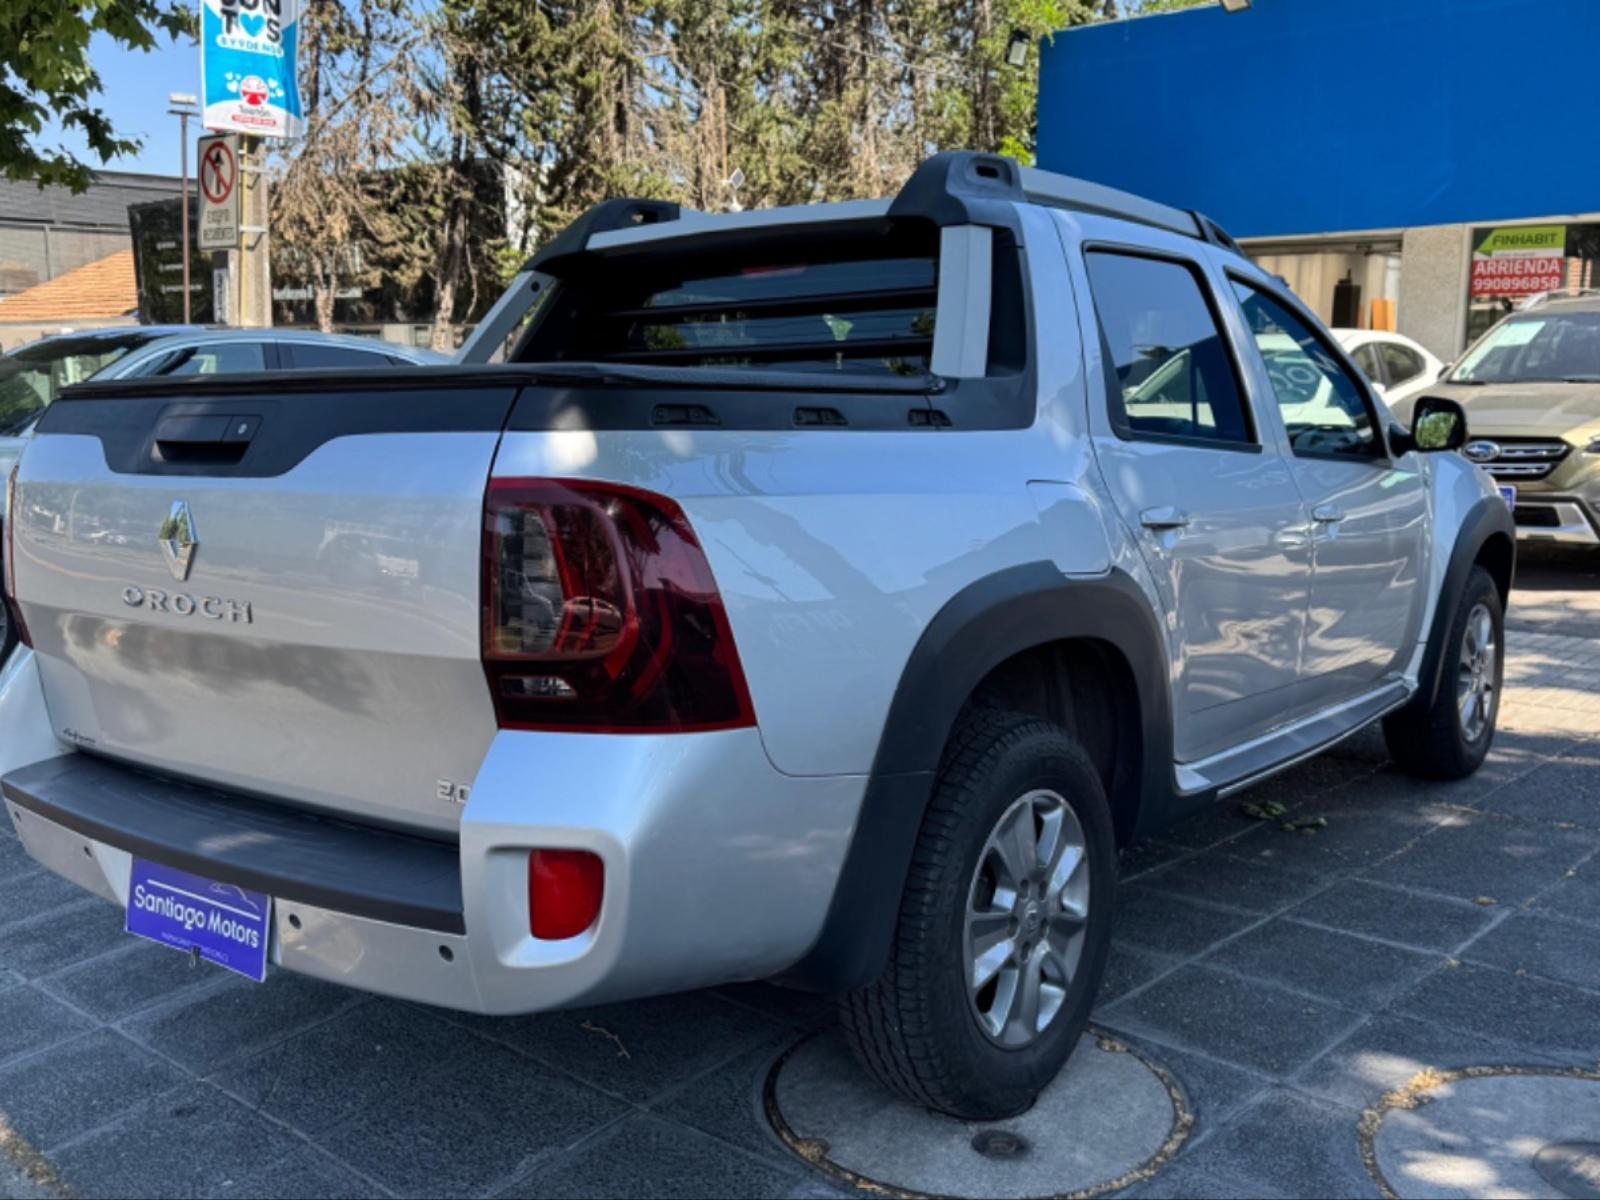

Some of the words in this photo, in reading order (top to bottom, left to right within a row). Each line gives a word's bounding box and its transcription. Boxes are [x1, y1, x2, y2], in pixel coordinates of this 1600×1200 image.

[1492, 233, 1558, 246] FINHABIT
[1475, 259, 1560, 275] ARRIENDA
[122, 586, 253, 624] OROCH
[134, 884, 206, 930] Santiago
[207, 910, 260, 949] Motors
